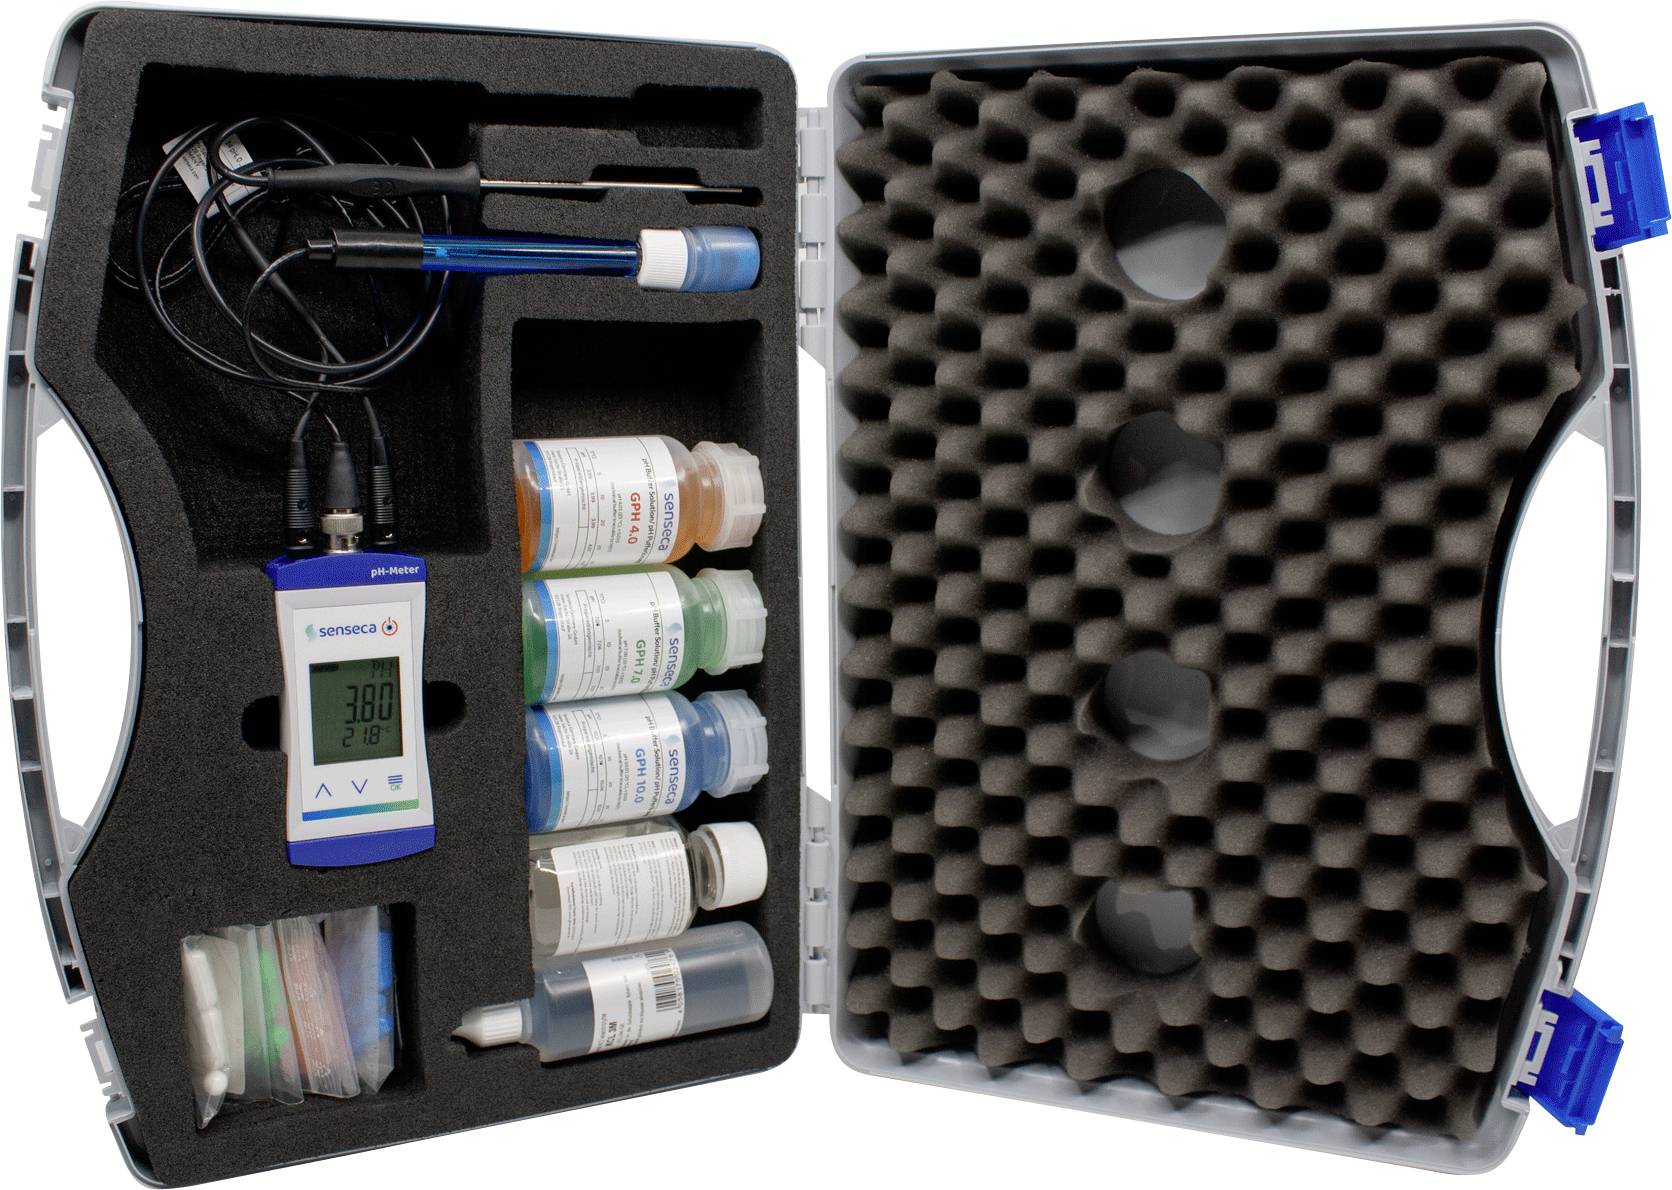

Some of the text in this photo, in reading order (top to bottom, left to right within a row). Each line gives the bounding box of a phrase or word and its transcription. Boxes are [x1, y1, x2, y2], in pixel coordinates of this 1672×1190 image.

[627, 492, 641, 545] GPH 4.0
[648, 491, 658, 525] Solution/
[658, 492, 674, 551] senseca
[370, 566, 420, 578] pH-Meter
[319, 623, 378, 637] senseca
[652, 612, 661, 636] Buffer
[630, 639, 646, 684] GPH 7.0
[653, 636, 662, 667] Solution/
[344, 682, 394, 724] 3.80
[634, 748, 647, 804] GPH 10.0
[652, 748, 662, 781] Solution/
[664, 749, 679, 805] senseca
